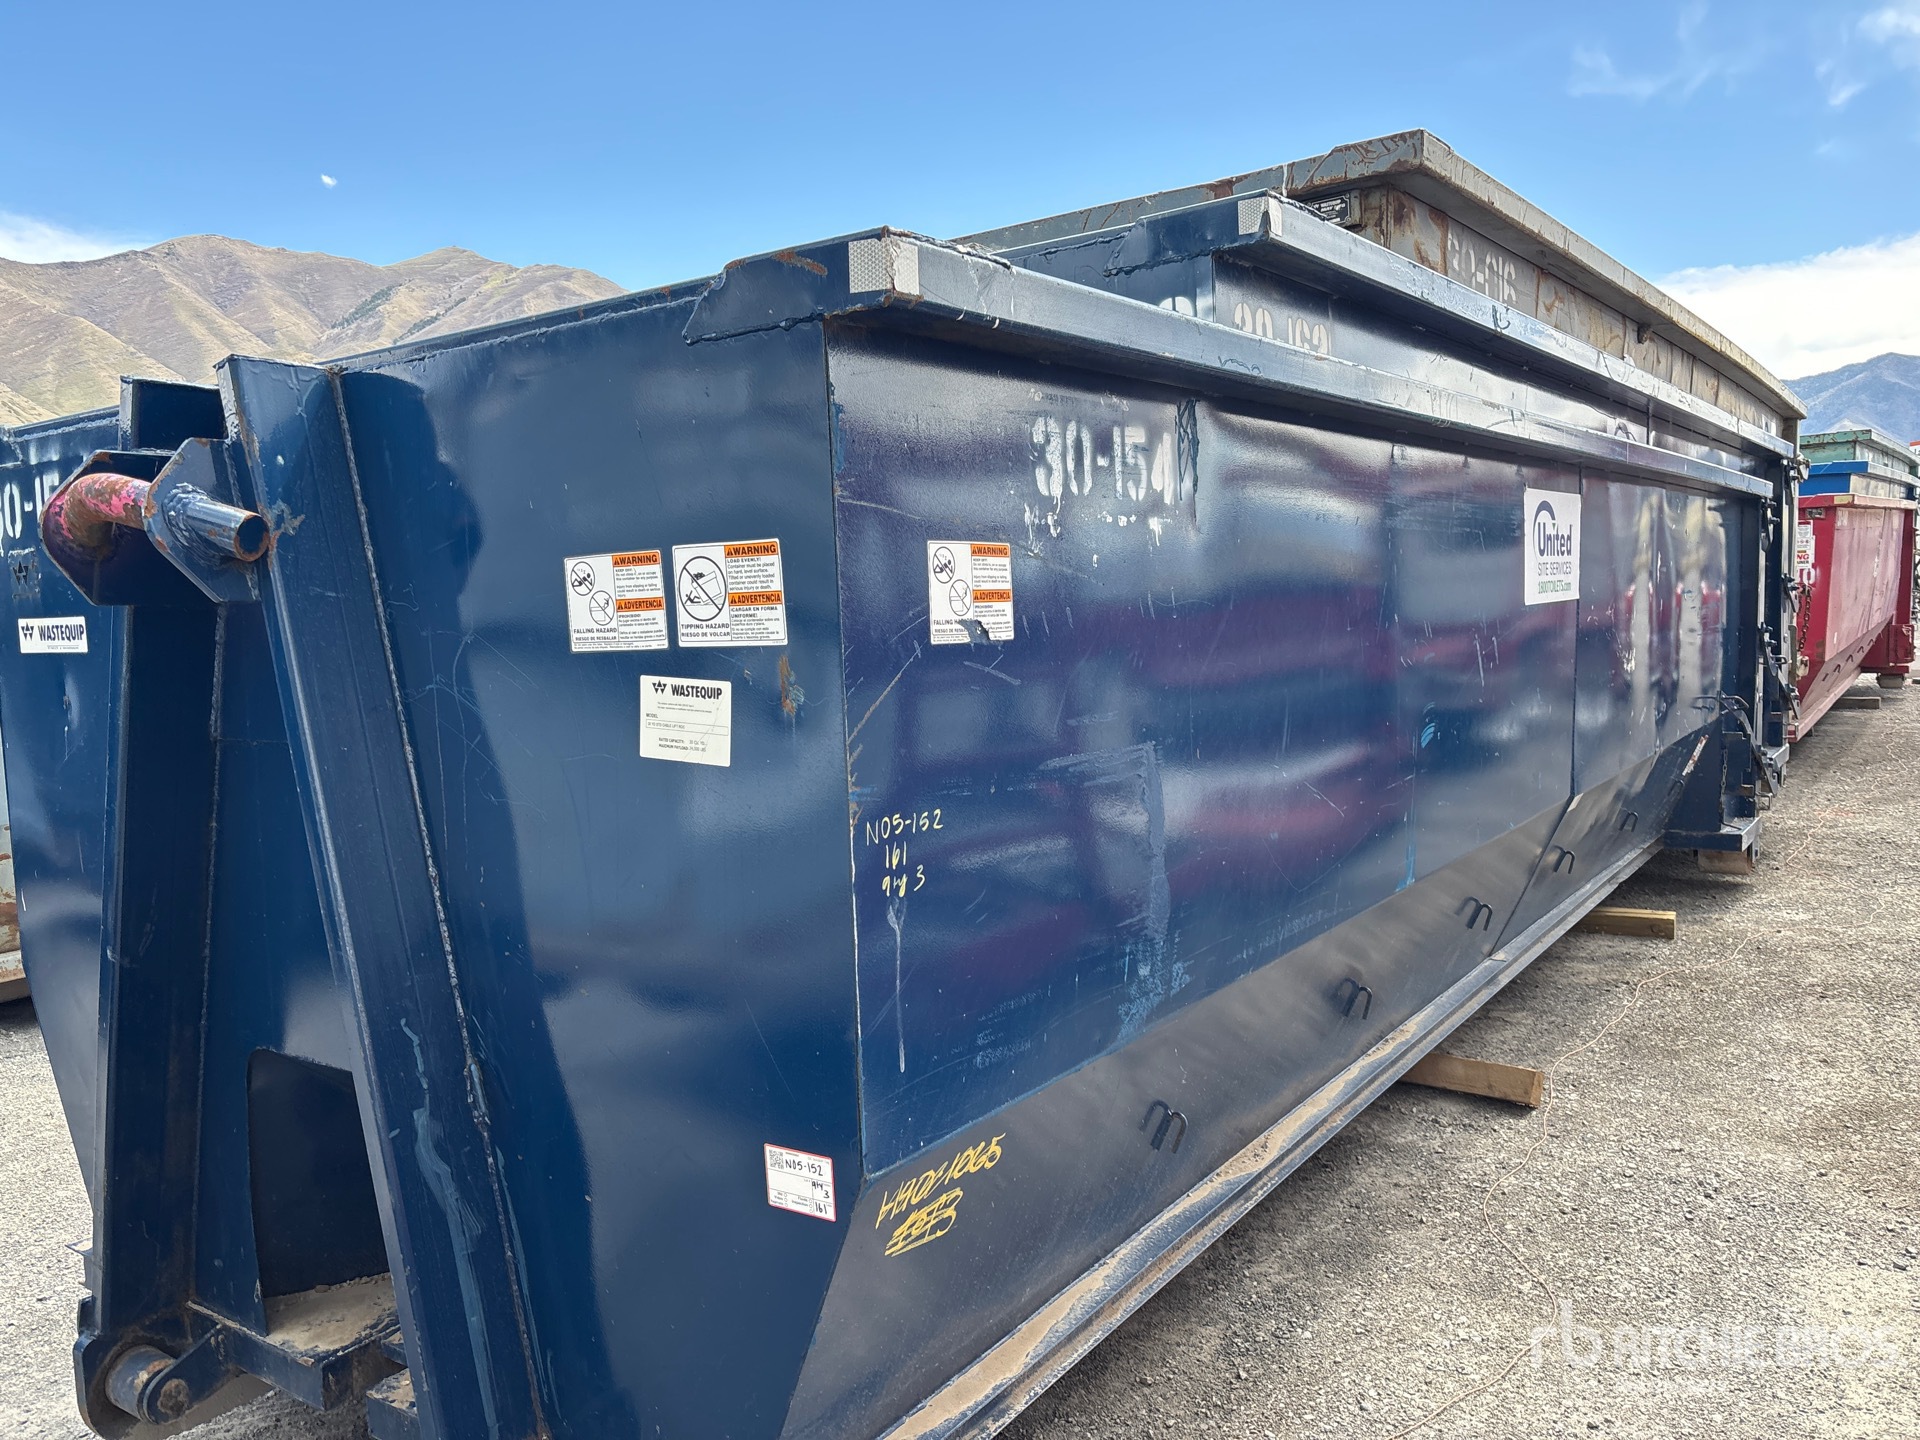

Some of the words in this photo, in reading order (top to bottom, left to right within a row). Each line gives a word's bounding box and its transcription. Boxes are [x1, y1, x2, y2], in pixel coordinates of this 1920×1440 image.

[1537, 521, 1572, 558] United
[733, 544, 777, 556] WARNING
[976, 547, 1008, 556] WARNING
[618, 554, 658, 565] WARNING
[1538, 561, 1549, 577] SITE
[1550, 560, 1572, 576] SERVICES
[737, 593, 782, 604] ADVERTENCIA
[980, 592, 1011, 601] ADVERTENCIA
[624, 600, 663, 609] ADVERTENCIA
[38, 624, 84, 642] WASTEQUIP
[705, 622, 730, 630] HAZARD
[671, 684, 722, 700] WASTEQUIP
[866, 808, 944, 846] N05-152
[886, 841, 907, 870] 161
[914, 864, 926, 892] 3
[785, 1159, 824, 1177] N05-152
[823, 1190, 830, 1199] 3
[815, 1201, 828, 1215] 161
